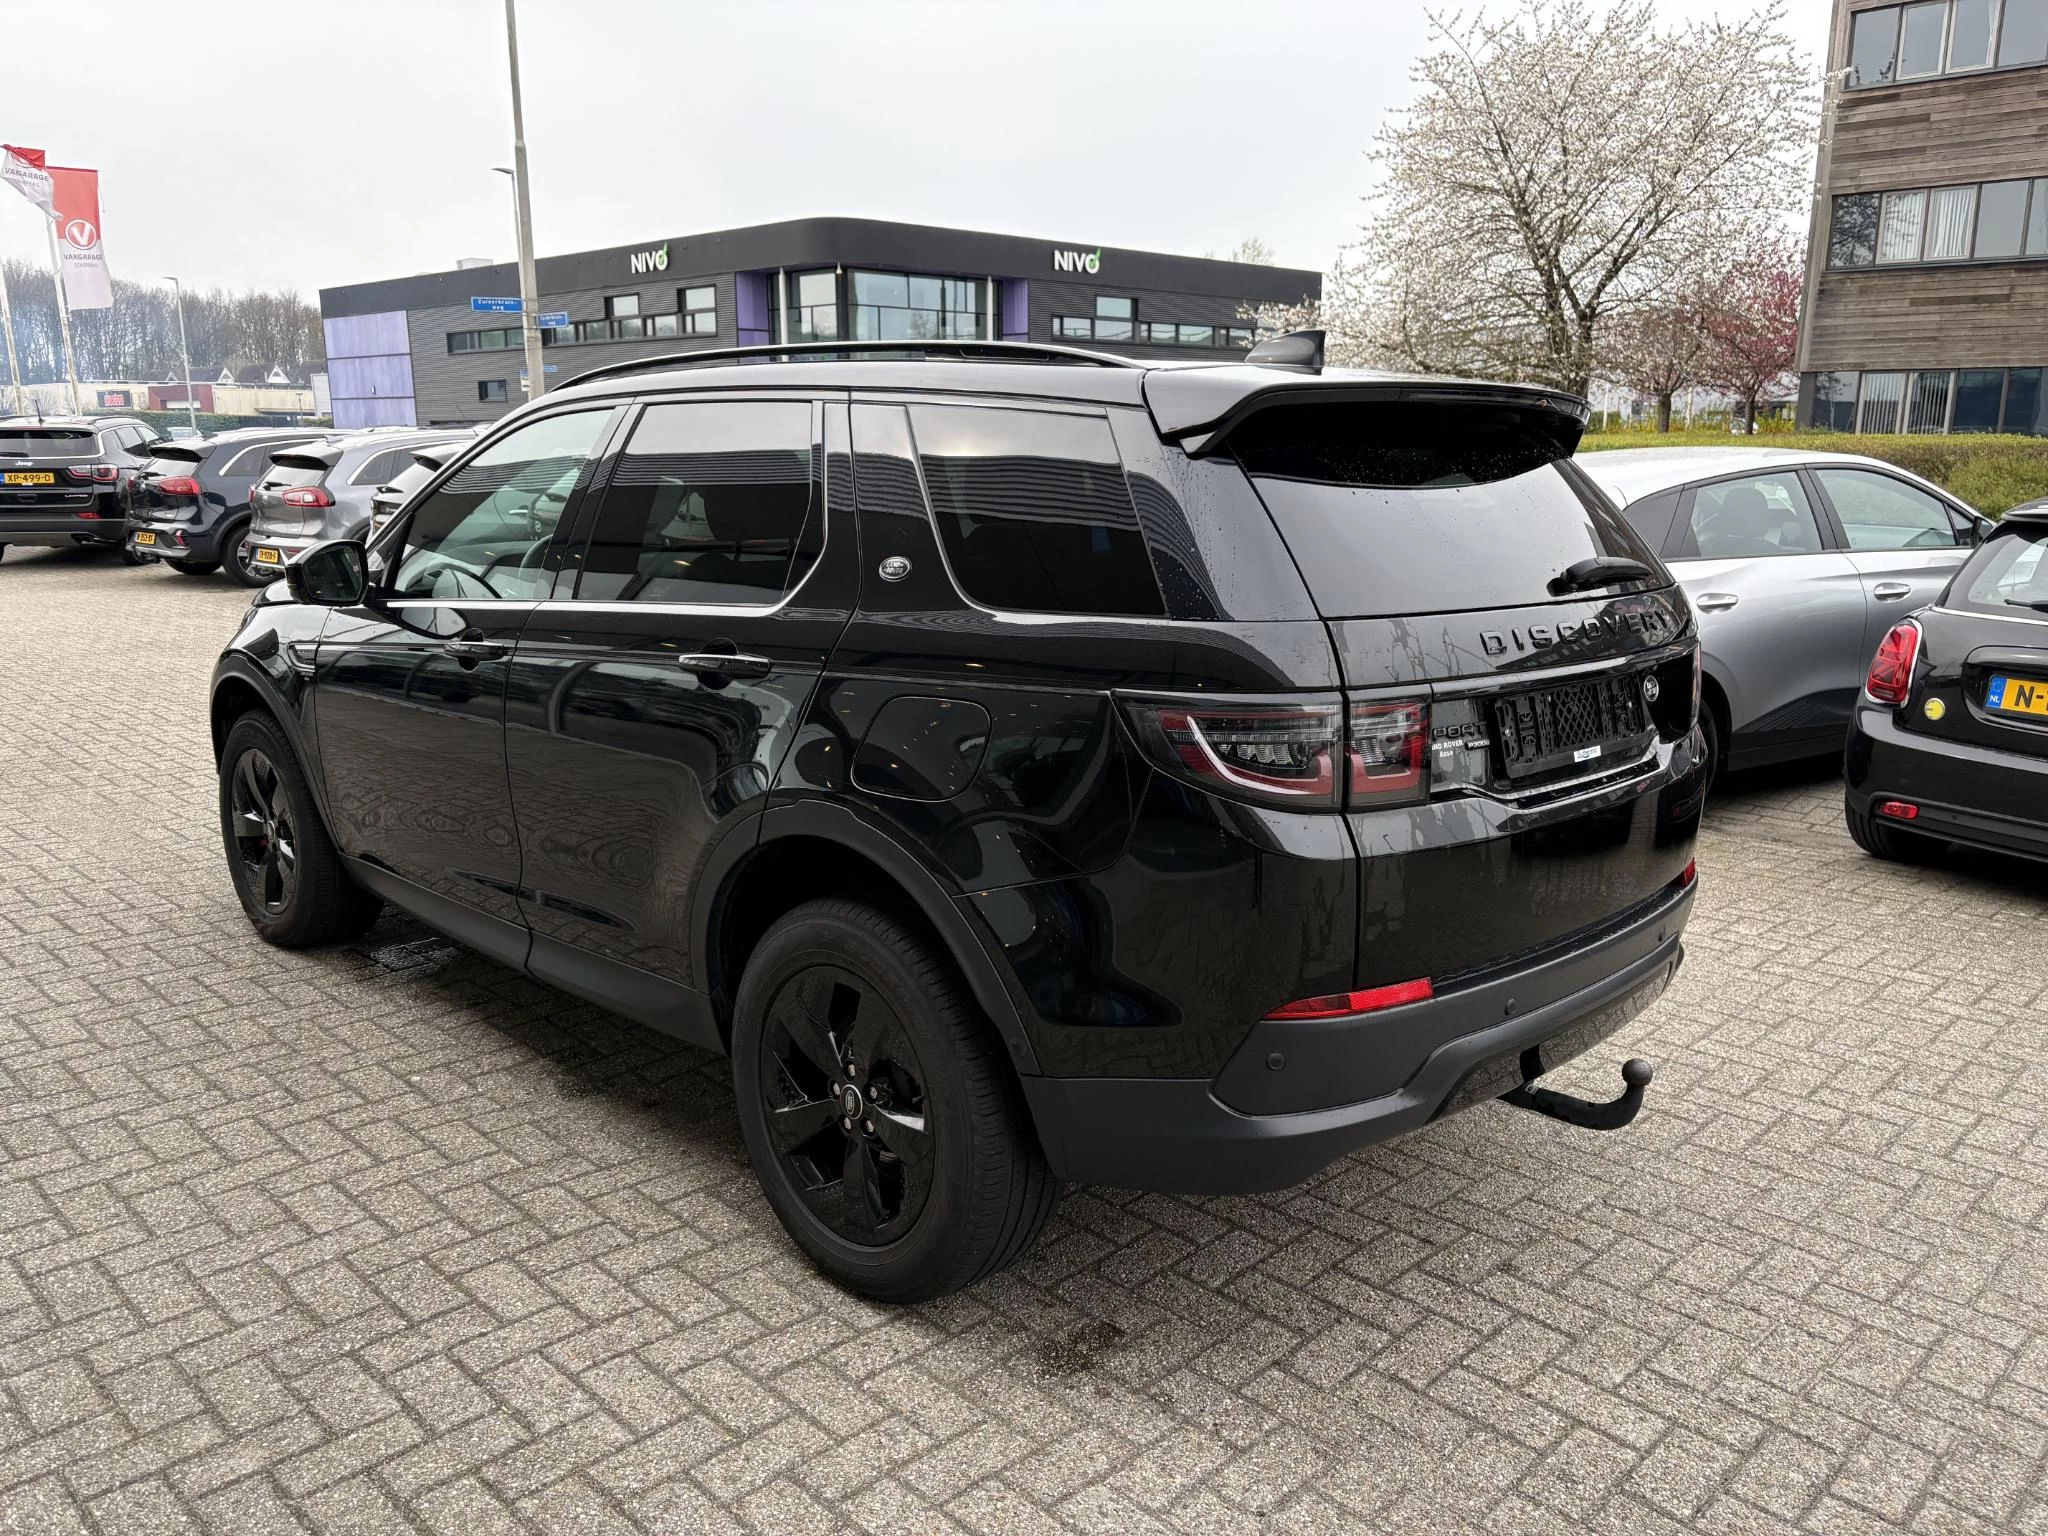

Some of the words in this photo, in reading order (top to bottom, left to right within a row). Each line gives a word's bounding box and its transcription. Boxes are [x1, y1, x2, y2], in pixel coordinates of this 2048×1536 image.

[630, 240, 668, 274] NIVO
[1053, 247, 1101, 274] NIVO
[7, 474, 51, 482] XP-499-D
[1990, 695, 2001, 704] NL
[2014, 684, 2048, 712] N-
